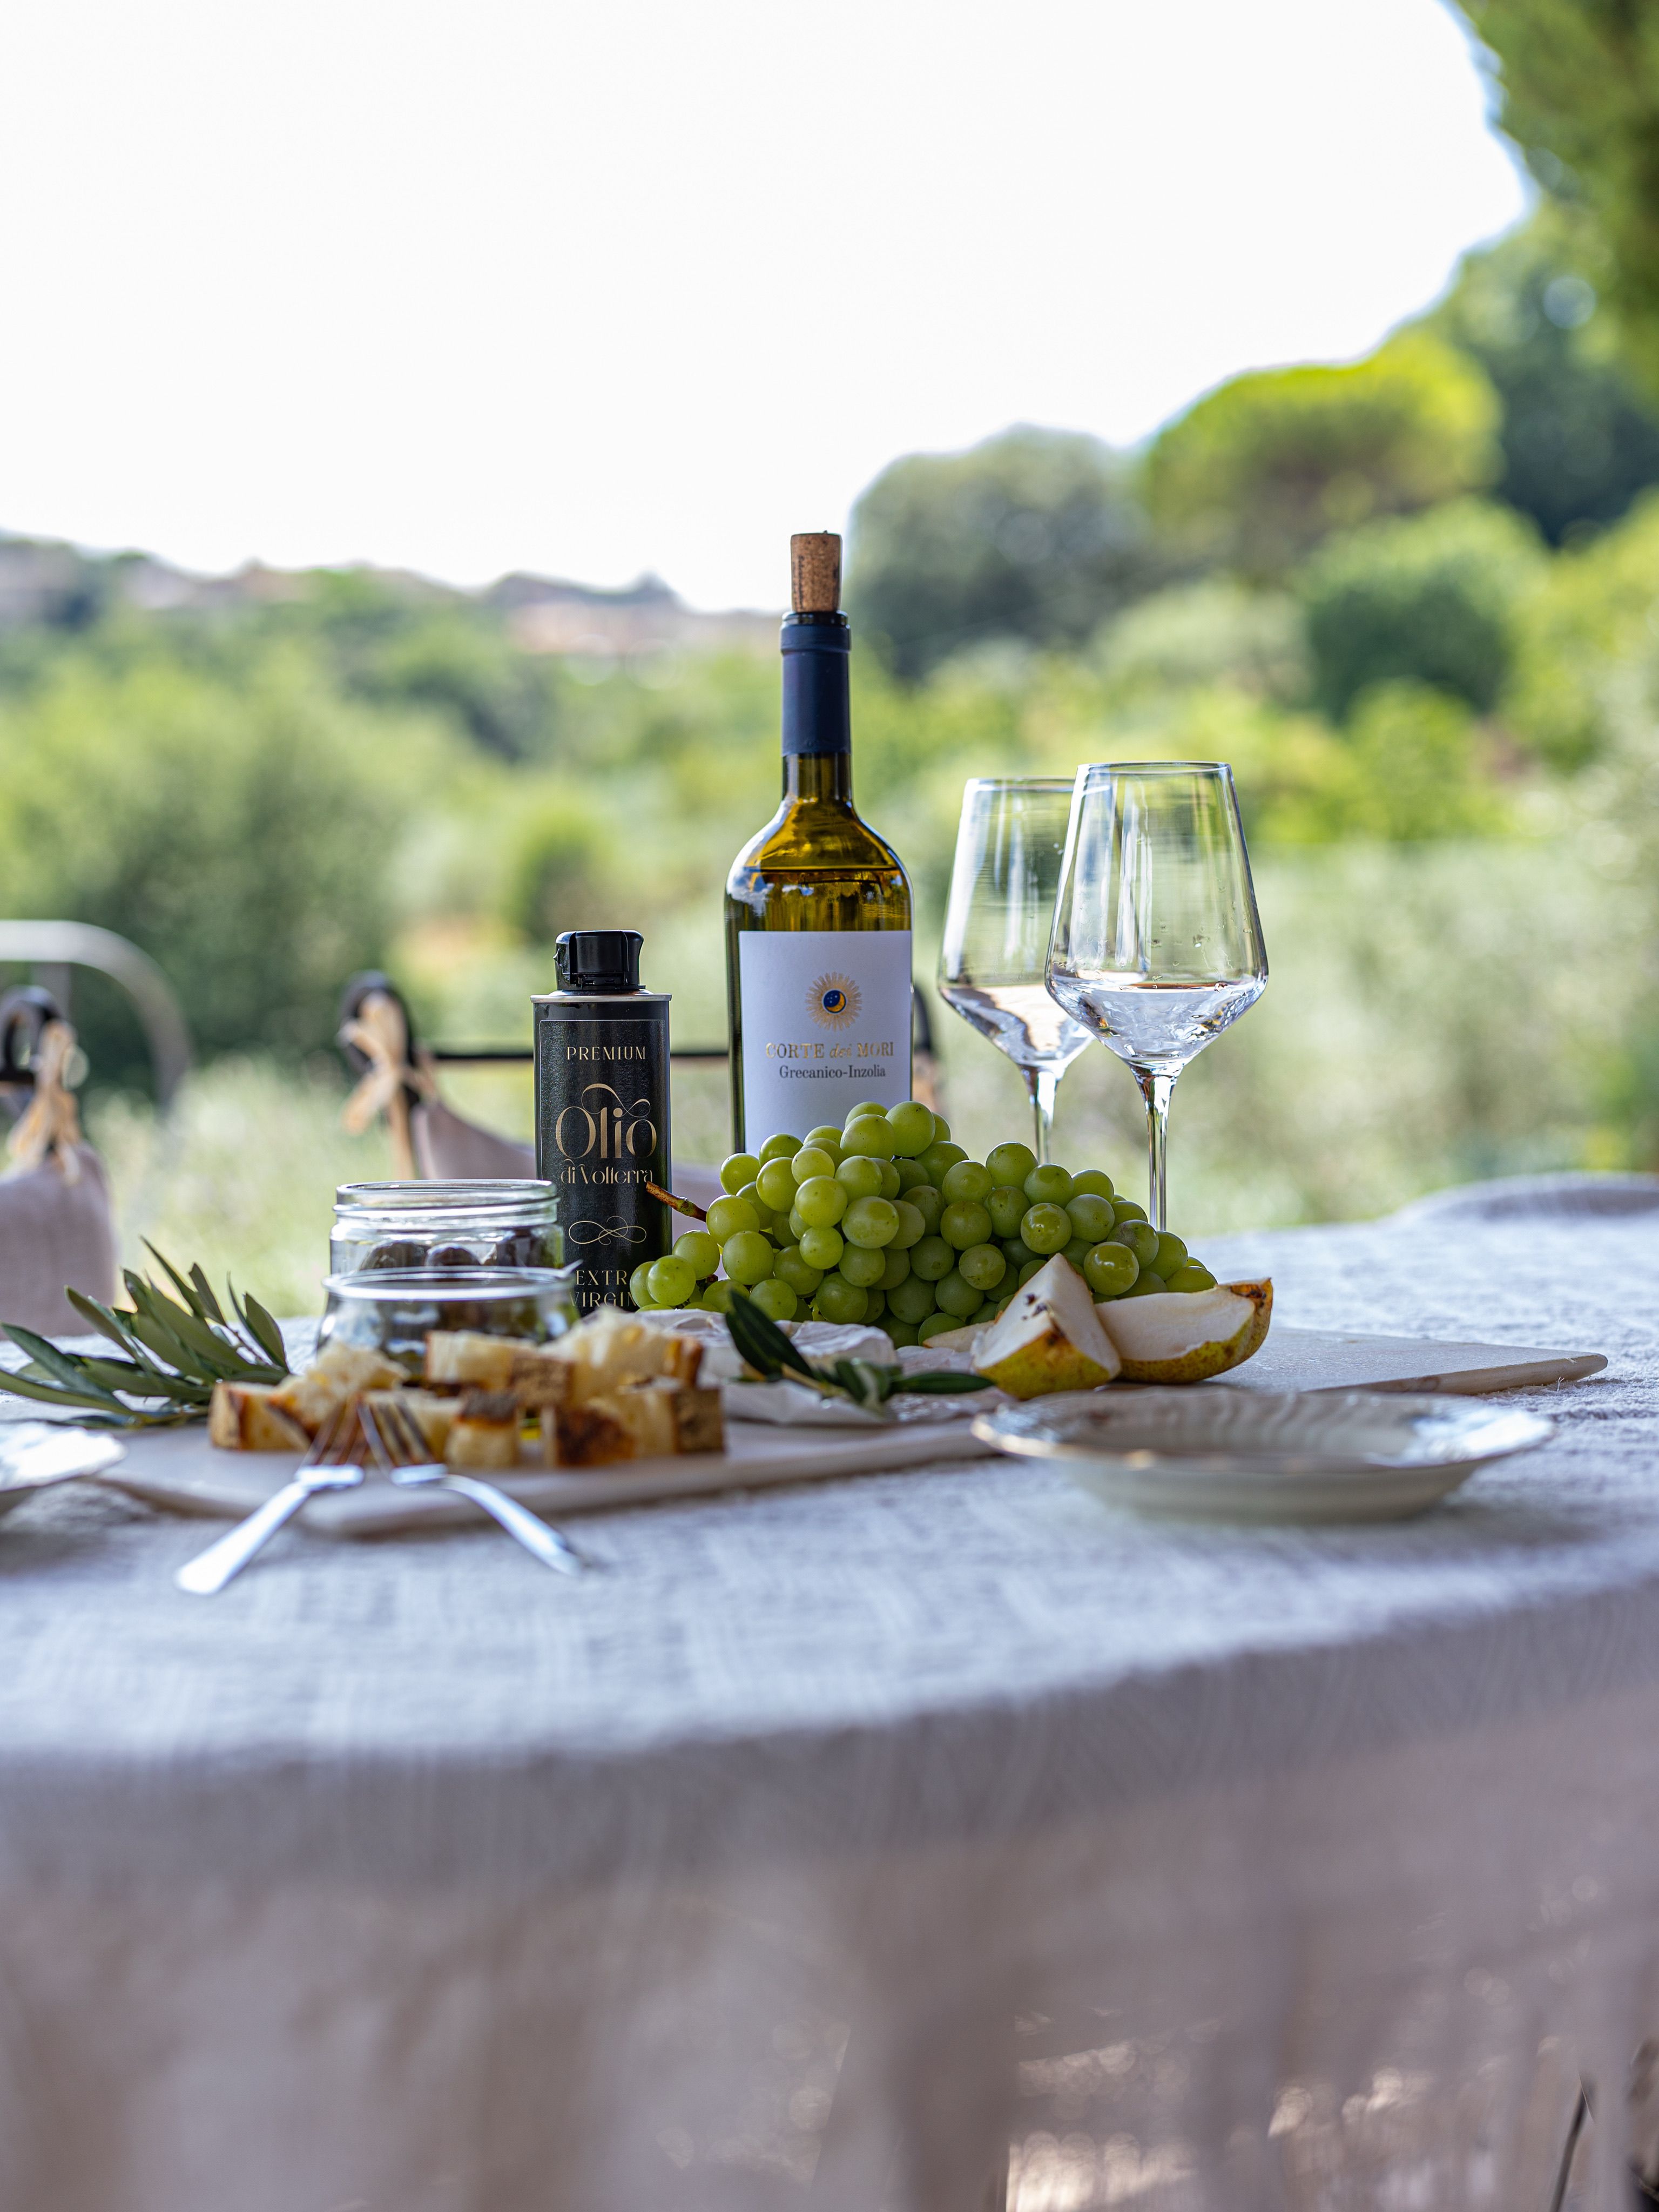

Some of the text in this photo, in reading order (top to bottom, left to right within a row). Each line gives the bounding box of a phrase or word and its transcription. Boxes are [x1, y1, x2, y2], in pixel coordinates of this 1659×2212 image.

[567, 1046, 646, 1060] PREMIUM
[766, 1042, 894, 1058] CORTE dei MORI
[779, 1063, 886, 1079] Grecanico-Inzolia
[555, 1083, 657, 1159] Olio
[561, 1158, 653, 1184] di Volterra
[576, 1270, 628, 1286] EXTR
